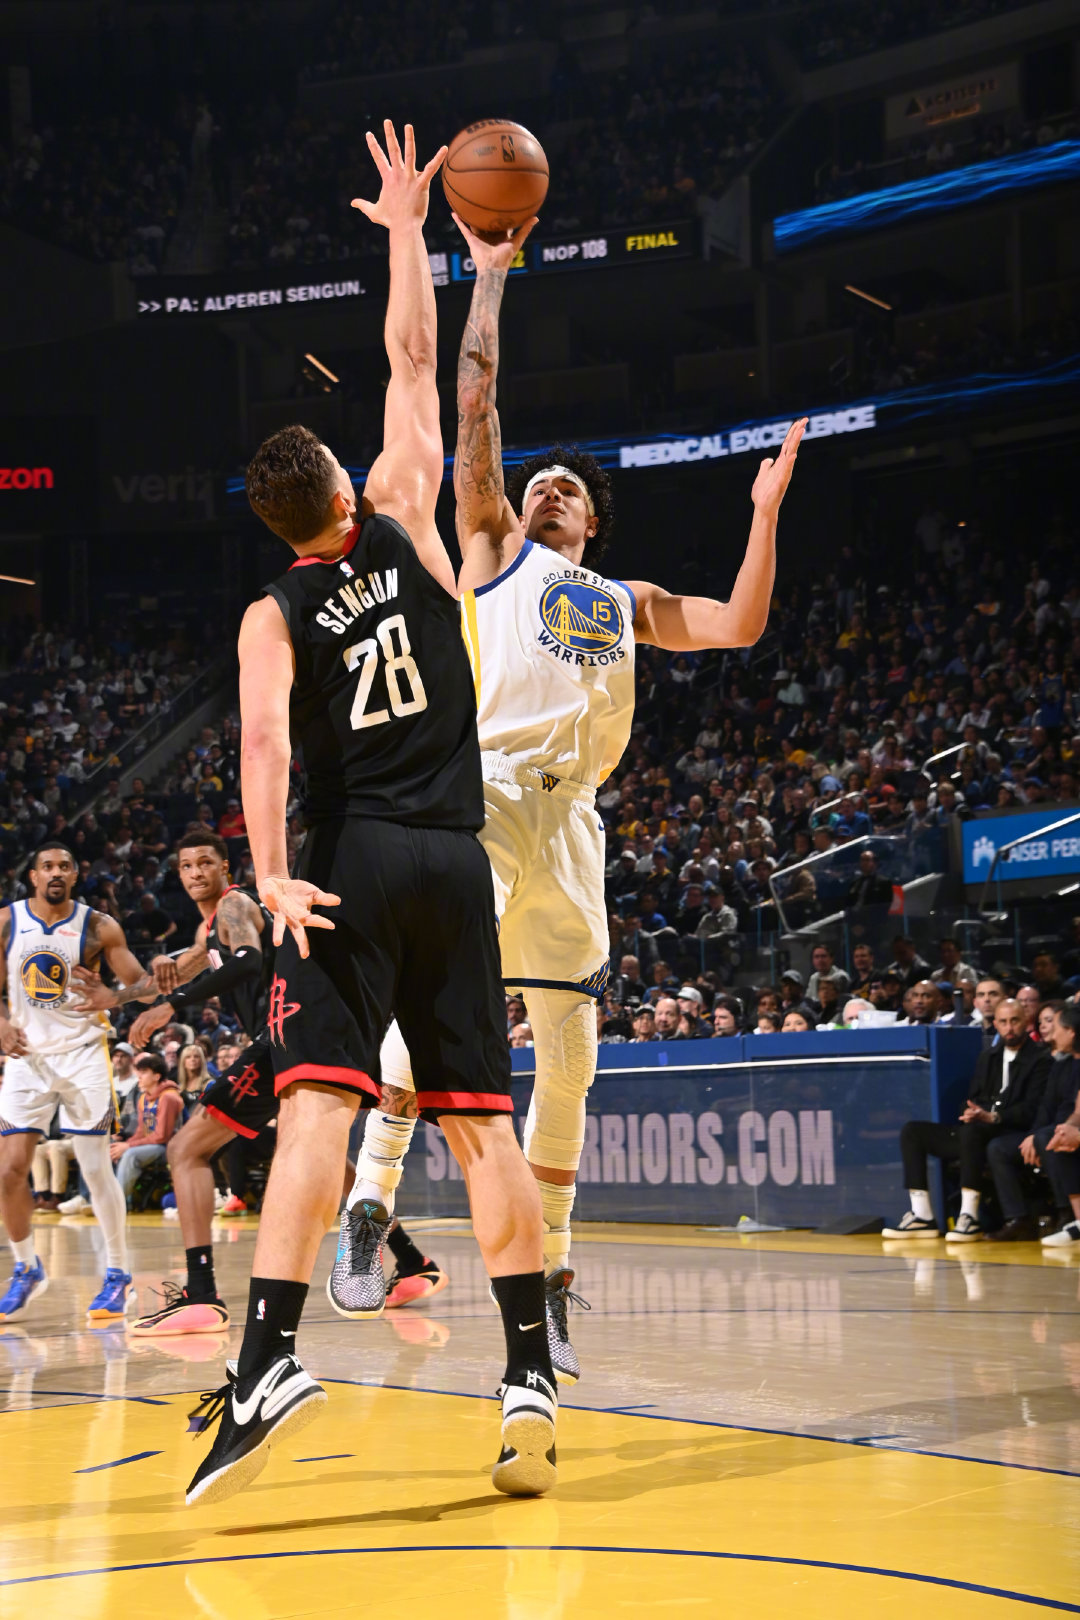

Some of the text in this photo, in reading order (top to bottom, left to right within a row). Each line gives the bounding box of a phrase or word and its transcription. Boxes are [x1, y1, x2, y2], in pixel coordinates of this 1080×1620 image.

[543, 246, 579, 262] NOP
[626, 232, 679, 251] FINAL
[166, 297, 199, 312] PA:
[203, 289, 282, 312] ALPEREN
[286, 280, 366, 303] SENGUN.
[620, 434, 729, 468] MEDICAL
[542, 570, 588, 585] GOLDEN
[315, 568, 399, 635] SENGUN
[592, 600, 612, 622] 15
[537, 629, 625, 667] WARRIORS
[343, 613, 428, 730] 28
[1003, 841, 1049, 863] AISER
[50, 965, 61, 979] 8
